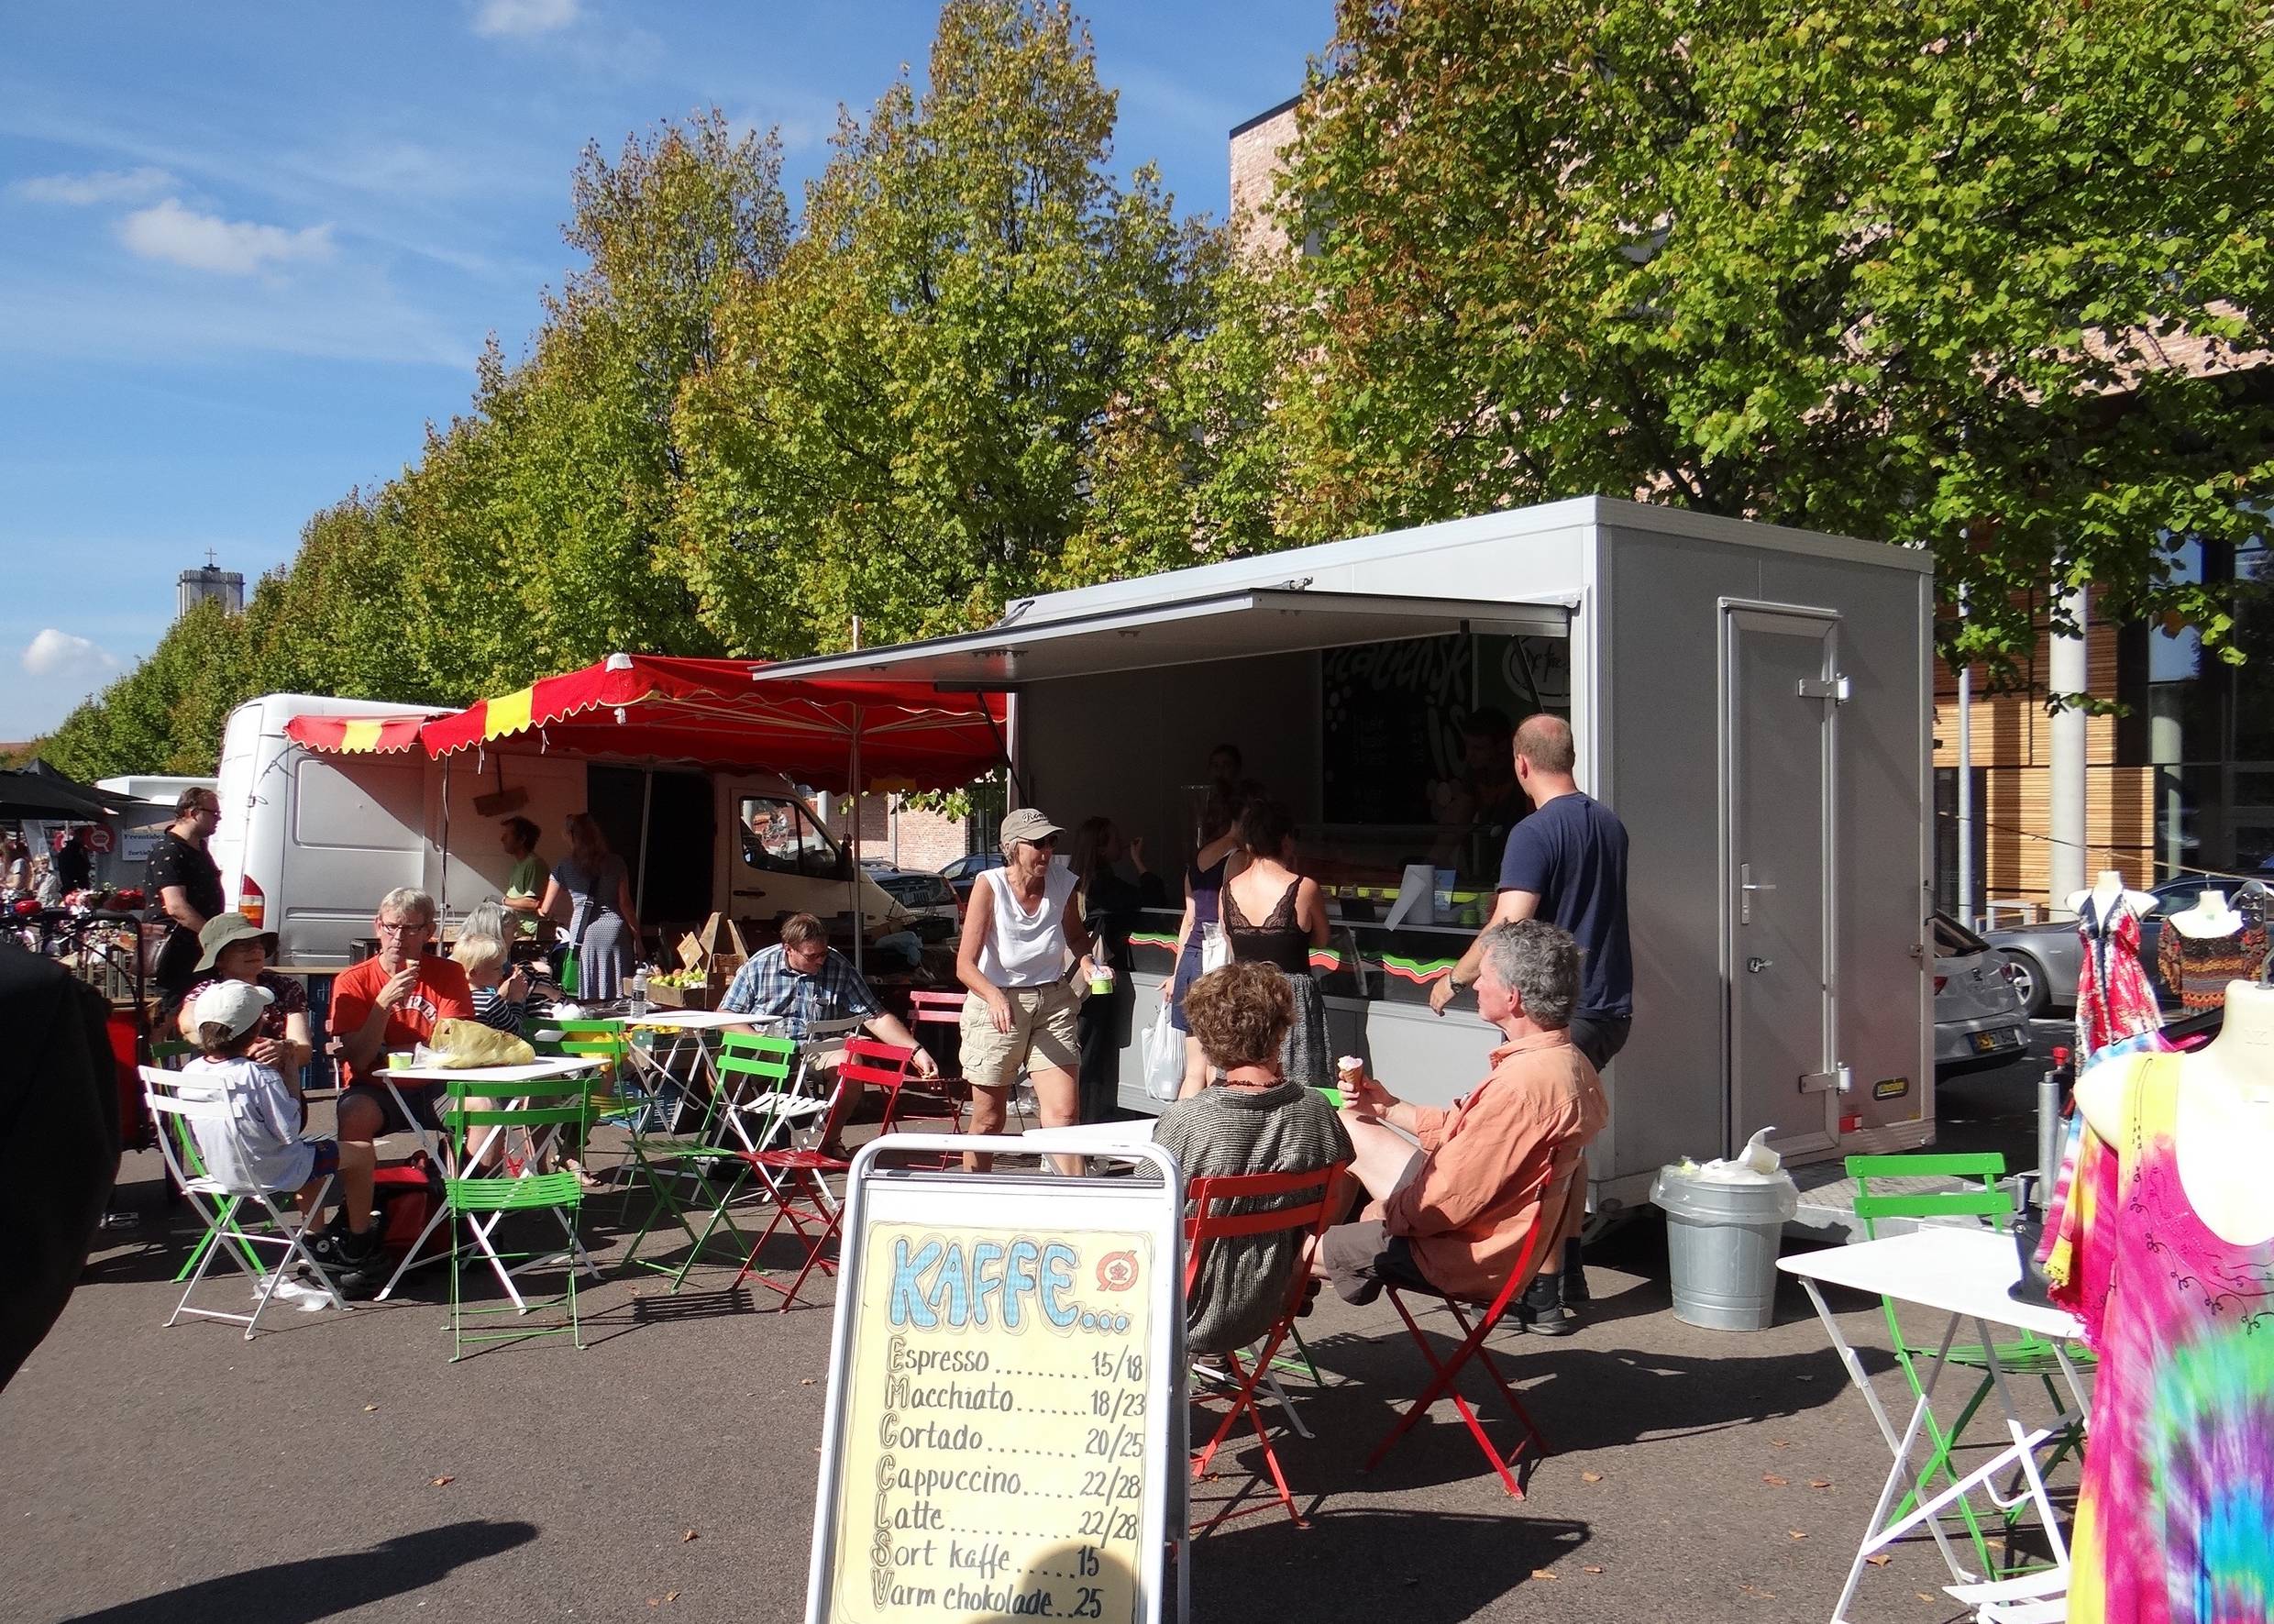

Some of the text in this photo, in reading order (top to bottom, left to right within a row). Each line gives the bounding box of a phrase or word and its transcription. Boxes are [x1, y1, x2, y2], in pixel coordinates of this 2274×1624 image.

[887, 1336, 1143, 1382] Espresso 15/18
[884, 1374, 1145, 1422] Macchiato 18/23
[880, 1412, 1144, 1464] Cortado 20/25
[877, 1453, 1141, 1507] Cappuccino 22/28
[875, 1493, 1137, 1548] Latte 22/28
[871, 1529, 937, 1567] Sort
[1078, 1544, 1100, 1577] 15
[871, 1570, 1103, 1619] Varm chokolade 25
